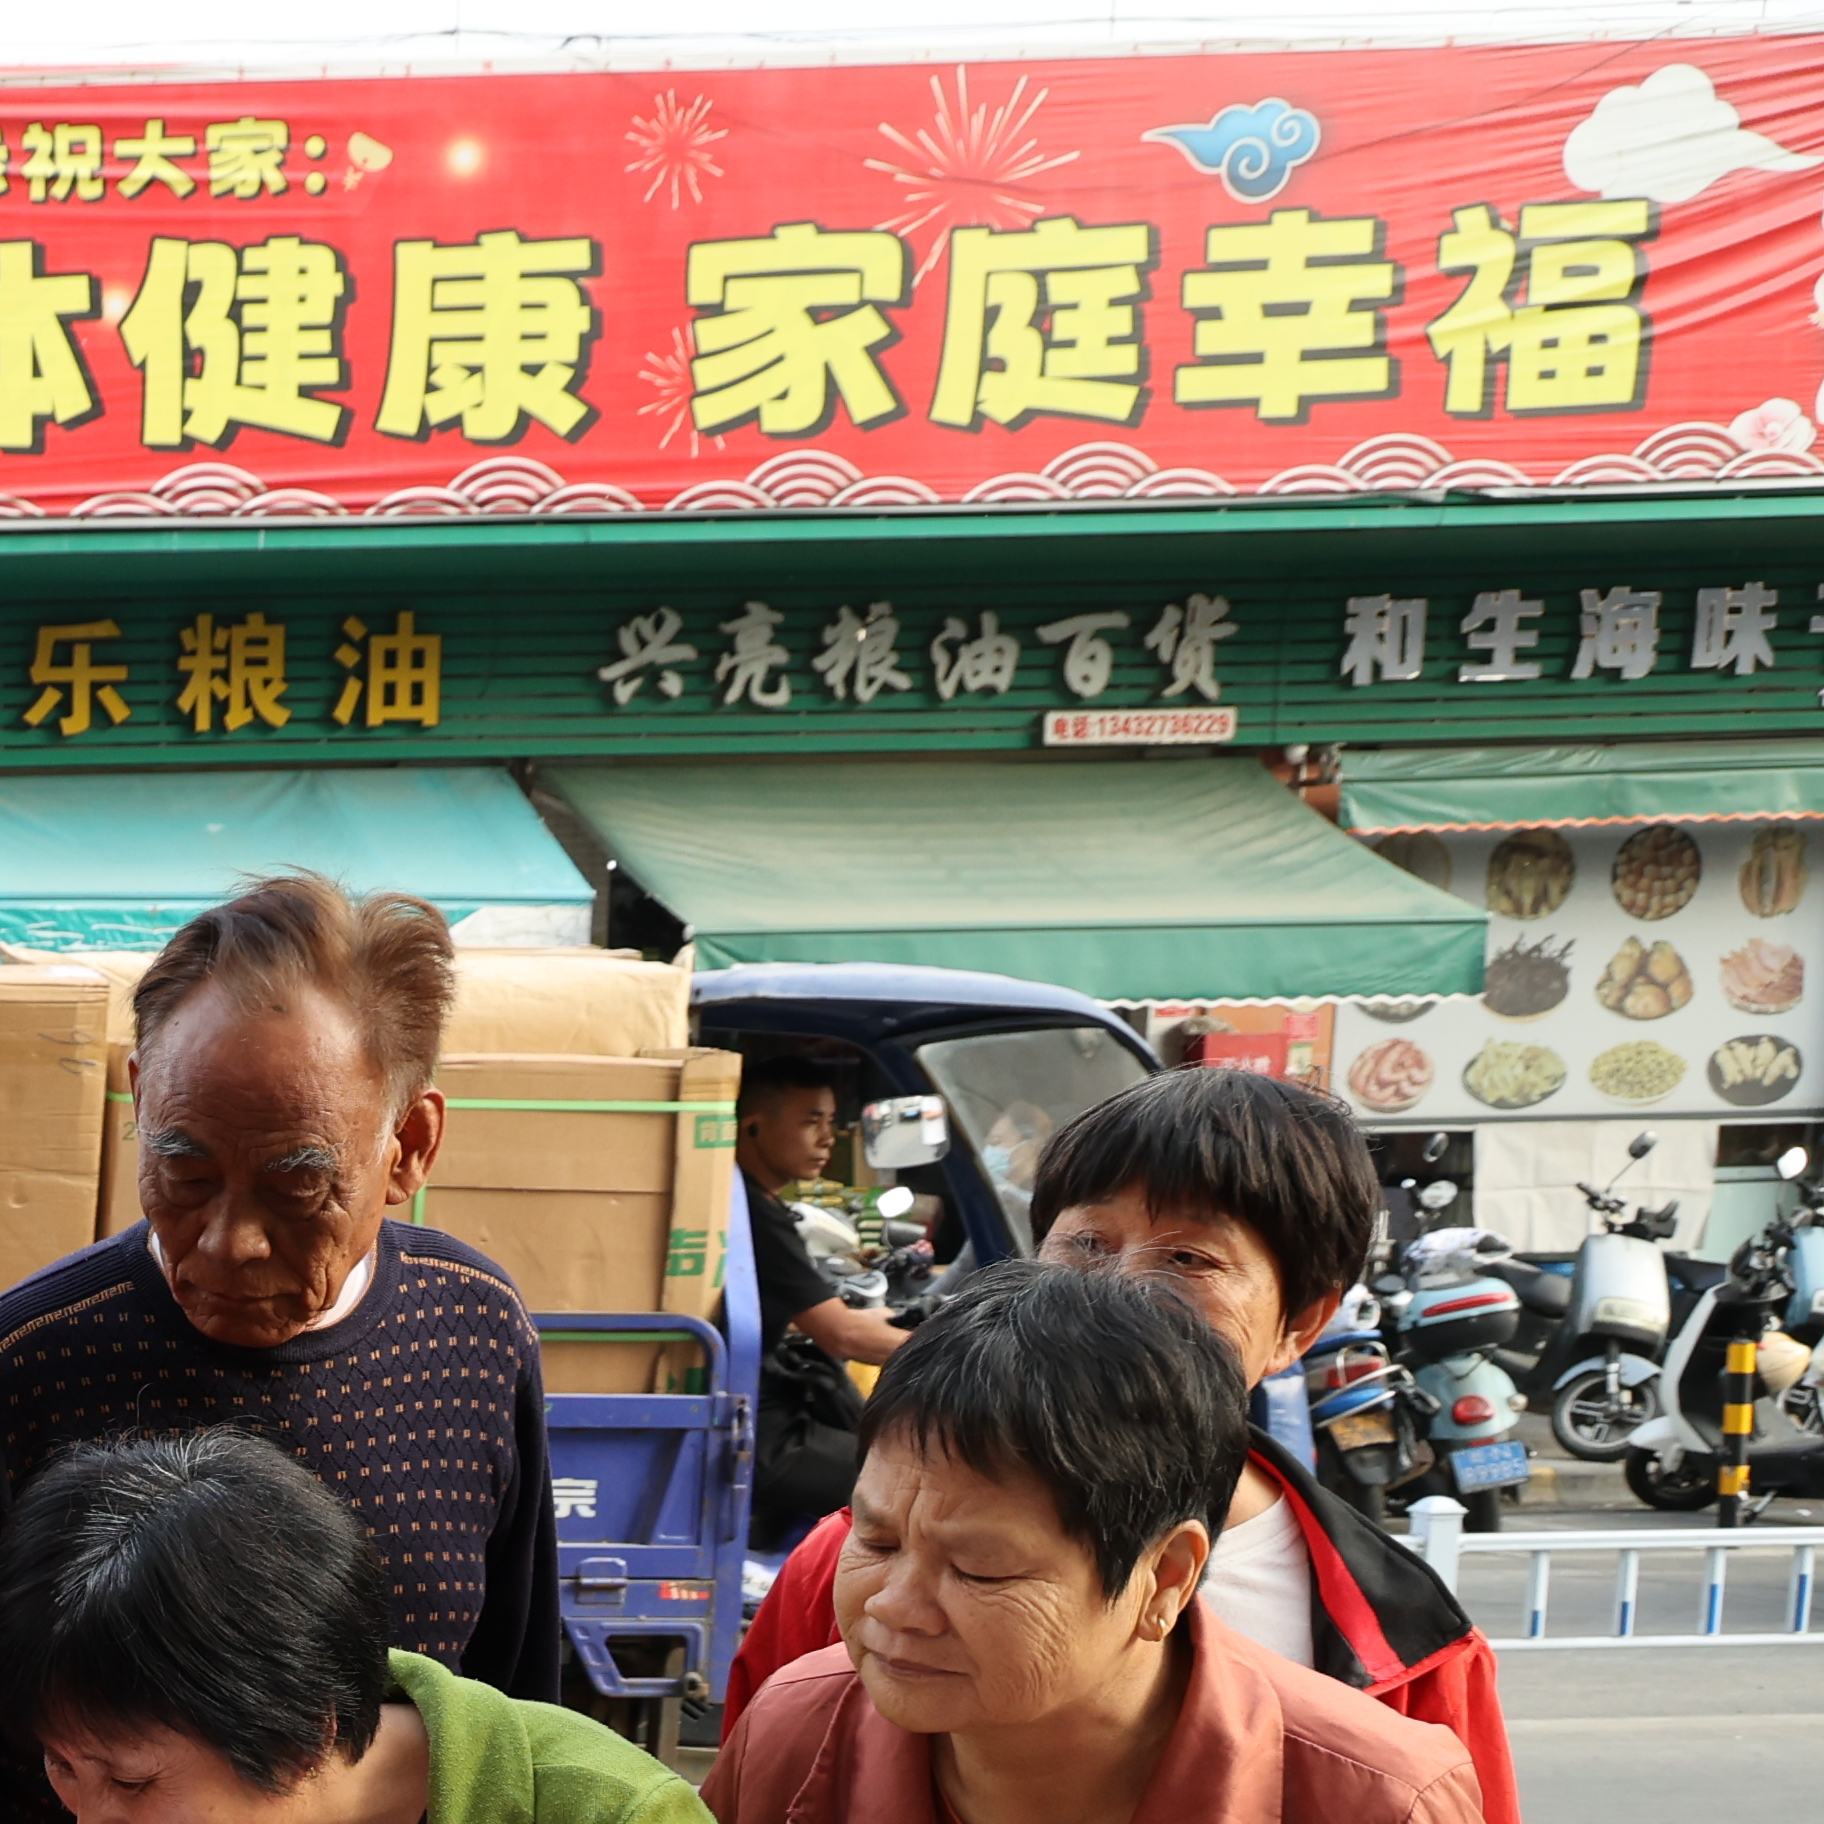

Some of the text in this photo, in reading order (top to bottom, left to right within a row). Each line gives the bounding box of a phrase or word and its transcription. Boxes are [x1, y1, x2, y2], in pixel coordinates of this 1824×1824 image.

[684, 198, 1662, 437] 家庭幸福
[598, 592, 1240, 706] 兴亮粮油百货
[1342, 580, 1824, 686] 和生海味
